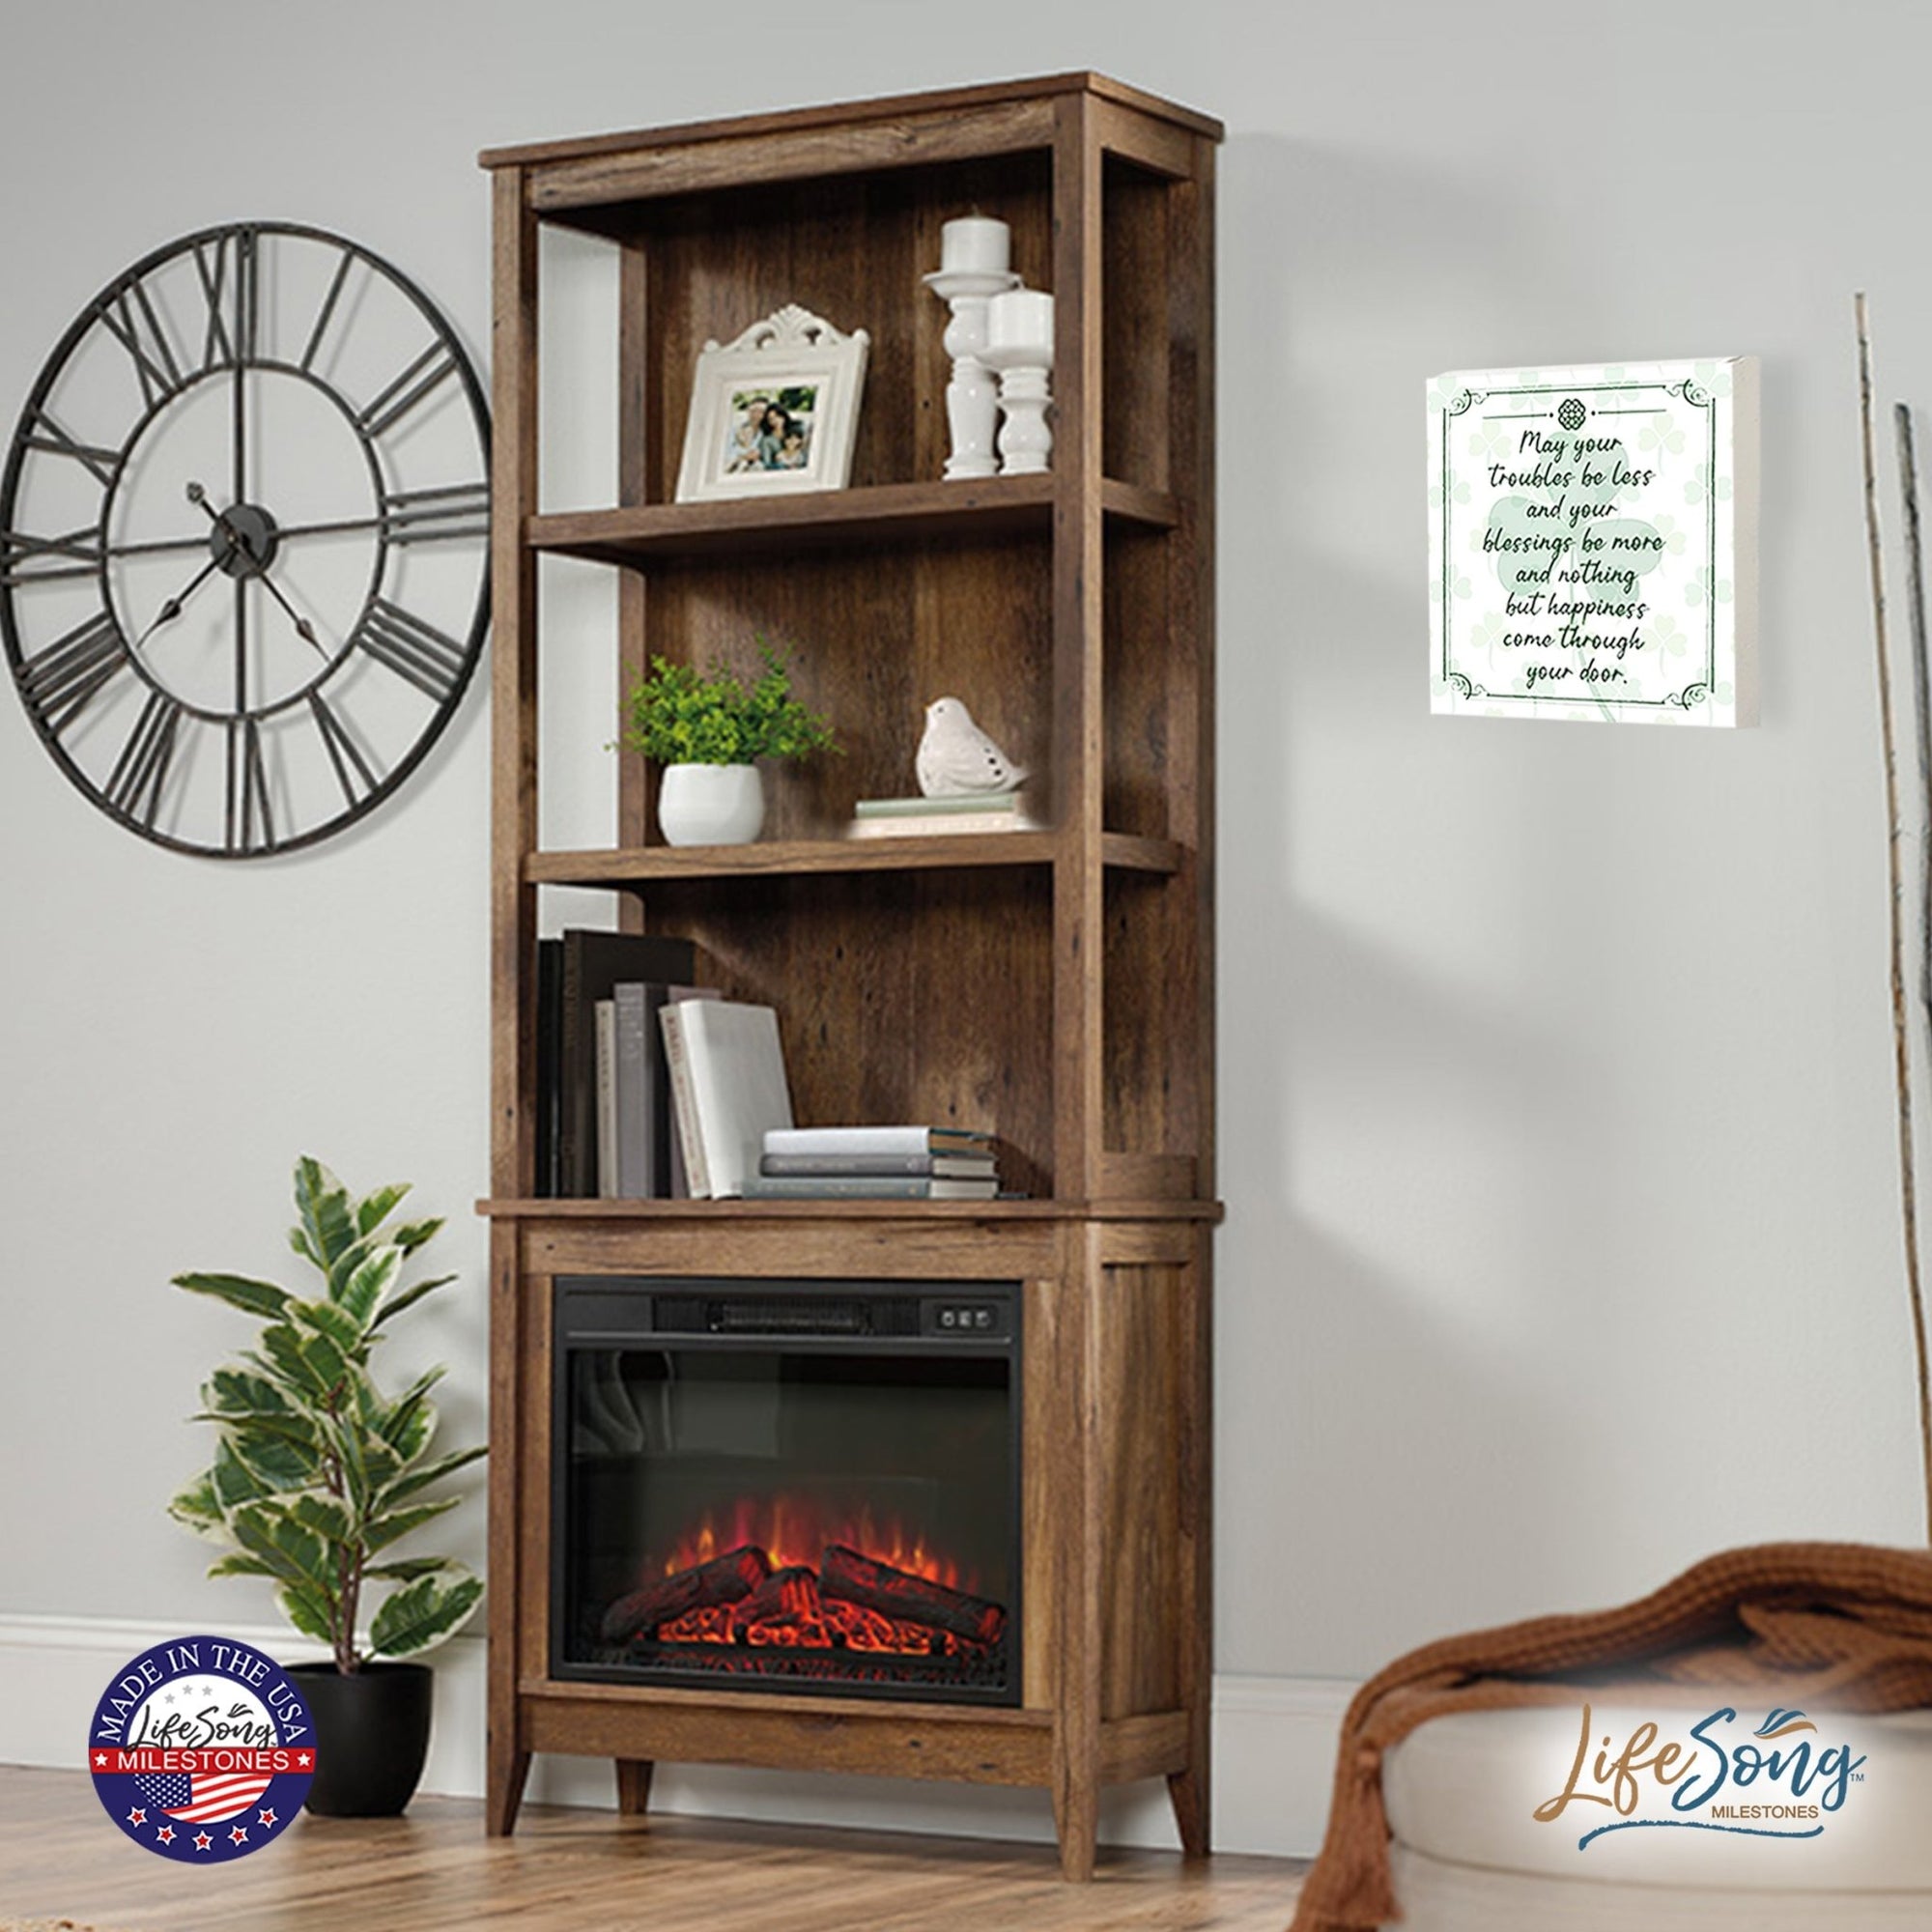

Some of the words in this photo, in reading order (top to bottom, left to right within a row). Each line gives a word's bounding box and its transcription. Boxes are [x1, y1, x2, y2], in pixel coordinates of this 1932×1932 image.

[1519, 430, 1569, 463] May
[1573, 438, 1623, 464] your
[1488, 463, 1576, 488] troubles
[1581, 462, 1607, 487] be
[1611, 460, 1656, 487] less
[1525, 494, 1566, 520] and
[1569, 503, 1618, 528] your
[1483, 527, 1576, 559] blessings
[1581, 527, 1607, 552] be
[1611, 537, 1666, 552] more
[1515, 557, 1558, 584] and
[1558, 559, 1637, 594] nothing
[1505, 591, 1546, 616] but
[1548, 593, 1651, 626] happiness
[1503, 632, 1556, 648] come
[1558, 626, 1645, 659] through
[1525, 666, 1574, 690] your
[1579, 659, 1628, 684] door.
